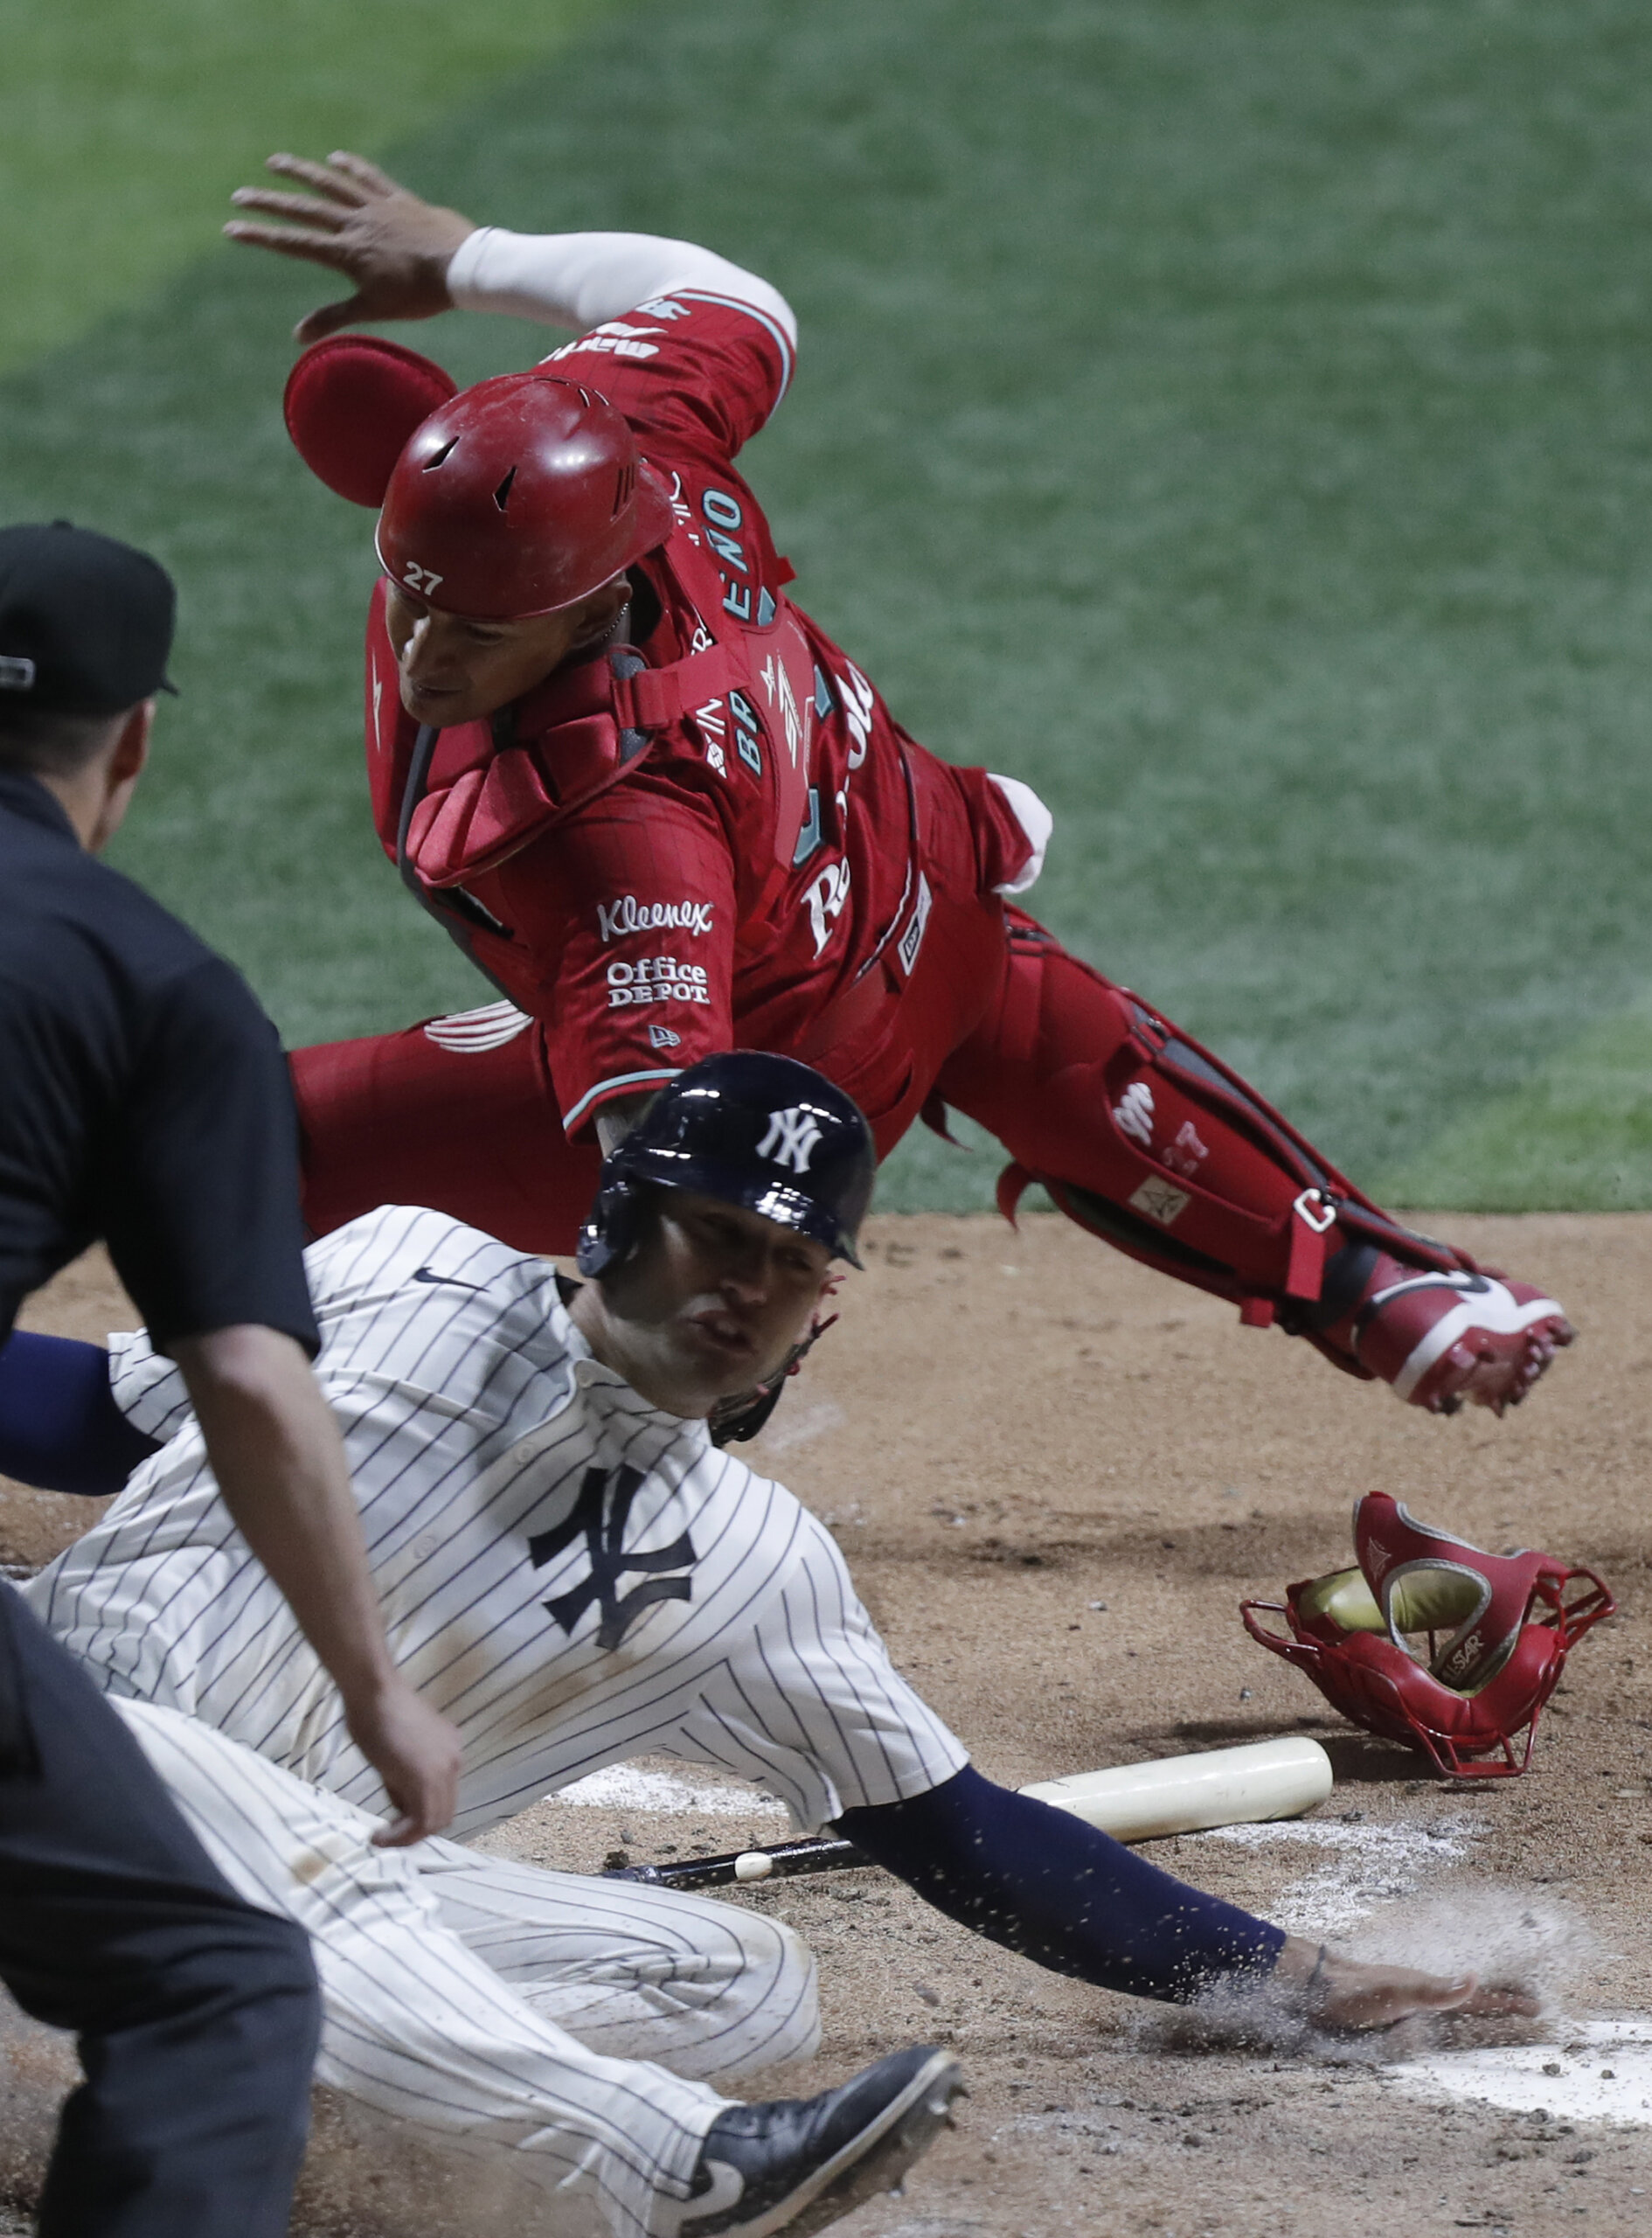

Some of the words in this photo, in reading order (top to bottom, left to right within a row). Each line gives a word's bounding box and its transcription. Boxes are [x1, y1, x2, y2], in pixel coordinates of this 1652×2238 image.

[402, 560, 443, 596] 27
[597, 894, 713, 942] Kleenex
[606, 956, 708, 986] Office
[607, 983, 711, 1008] DEPOT
[755, 1107, 824, 1174] NY
